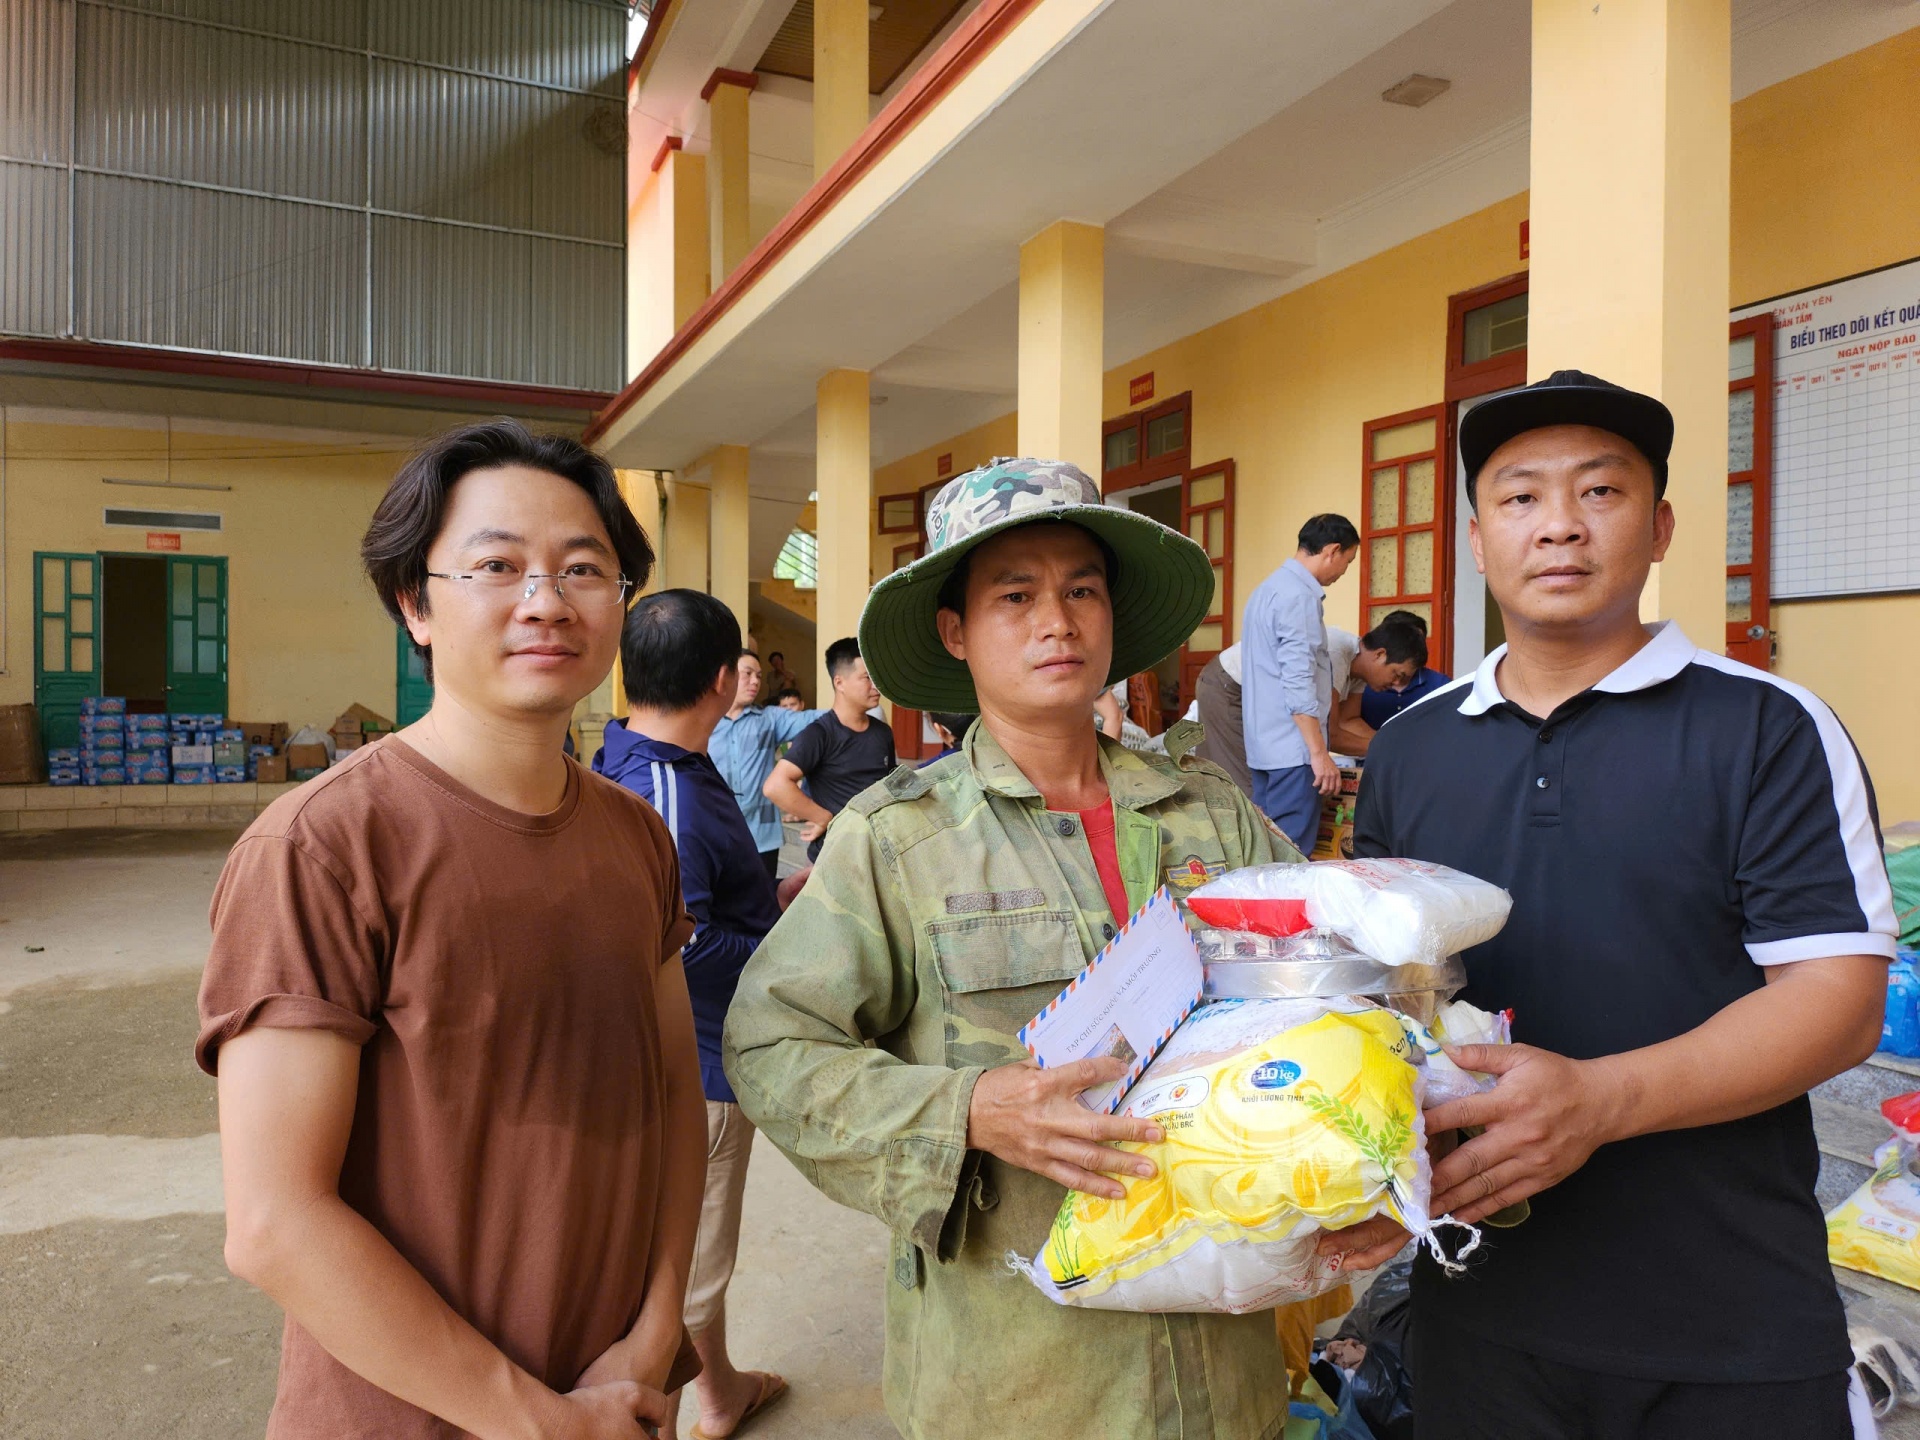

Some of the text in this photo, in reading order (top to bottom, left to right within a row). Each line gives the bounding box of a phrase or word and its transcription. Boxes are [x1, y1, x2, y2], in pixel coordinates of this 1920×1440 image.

[1790, 325, 1815, 349] BIỂU
[1819, 323, 1846, 343] THEO
[1850, 315, 1869, 335] DÕI
[1874, 305, 1895, 329] KẾT
[1257, 1067, 1295, 1084] 10 kg
[1180, 1120, 1194, 1129] BRC
